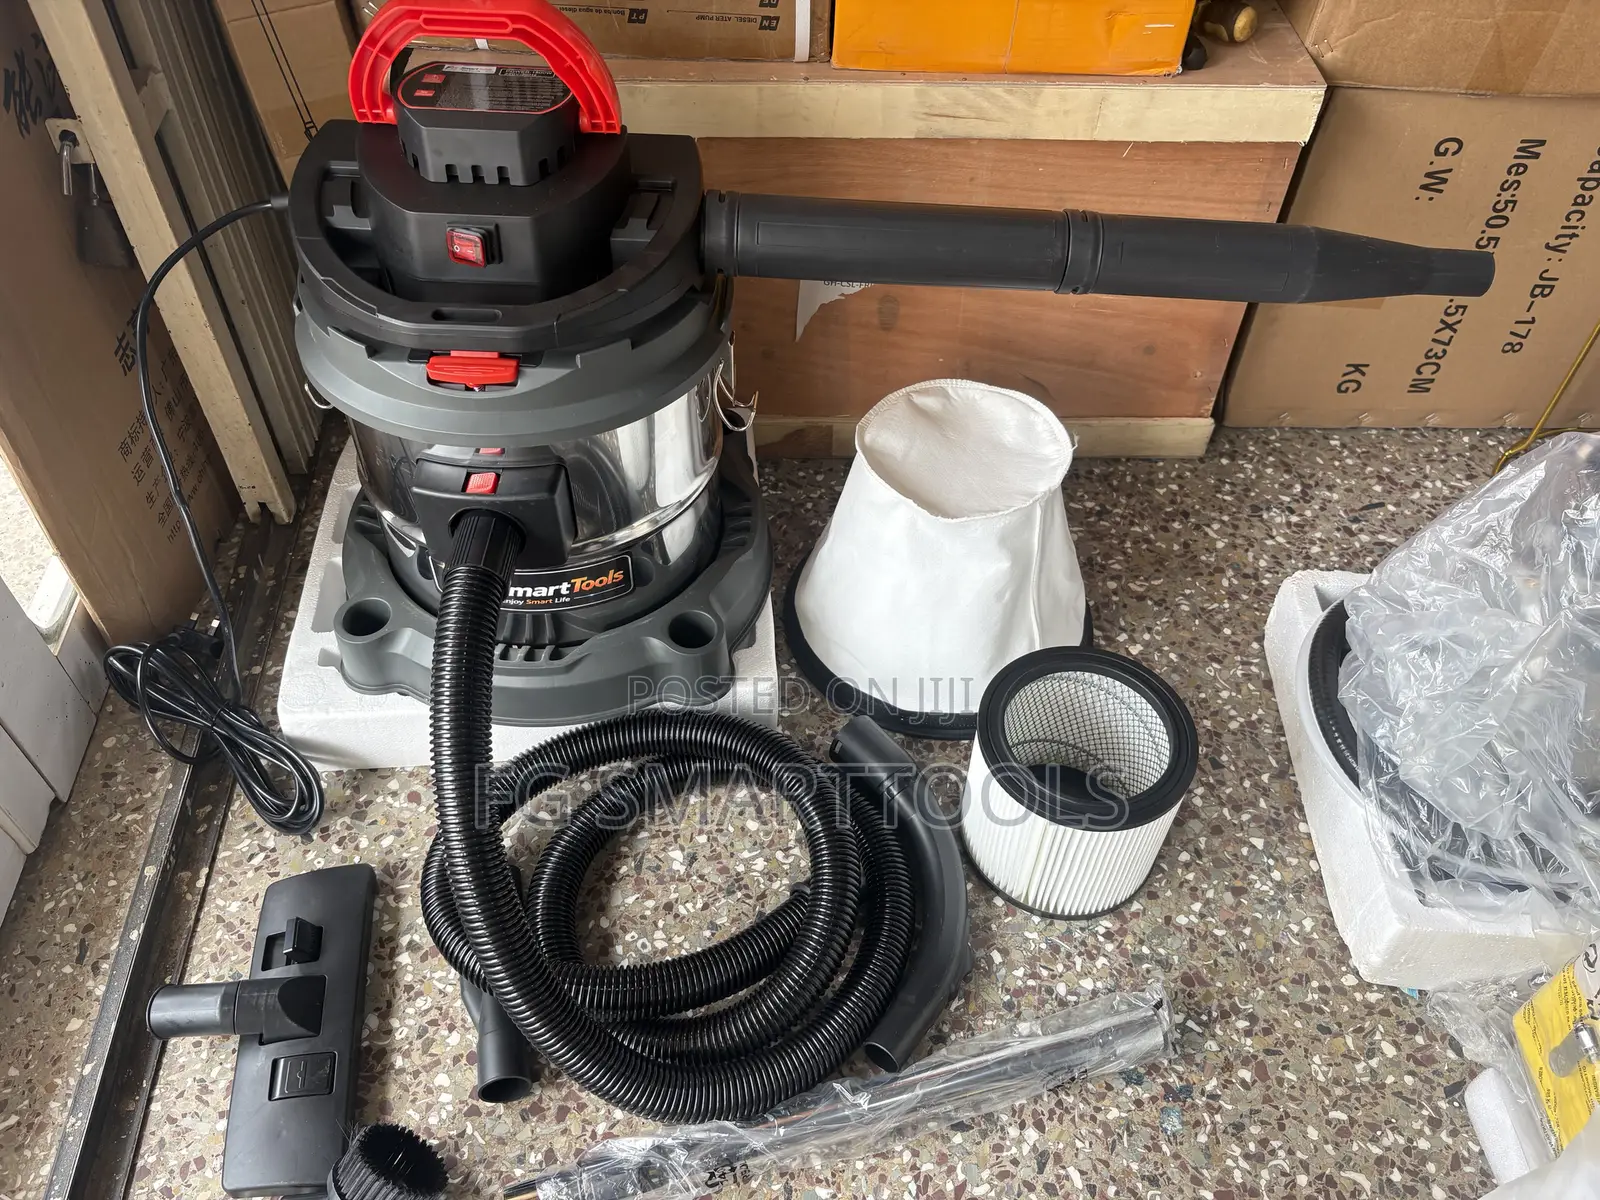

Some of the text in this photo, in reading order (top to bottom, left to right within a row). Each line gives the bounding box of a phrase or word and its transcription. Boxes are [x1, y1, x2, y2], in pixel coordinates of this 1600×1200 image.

[695, 14, 714, 22] PUMP
[734, 16, 757, 24] DIESEL
[1474, 138, 1548, 251] Mes:50.5
[1336, 137, 1464, 394] G.W: KG
[1501, 147, 1600, 355] apacity: JB-178
[508, 569, 625, 598] martTools
